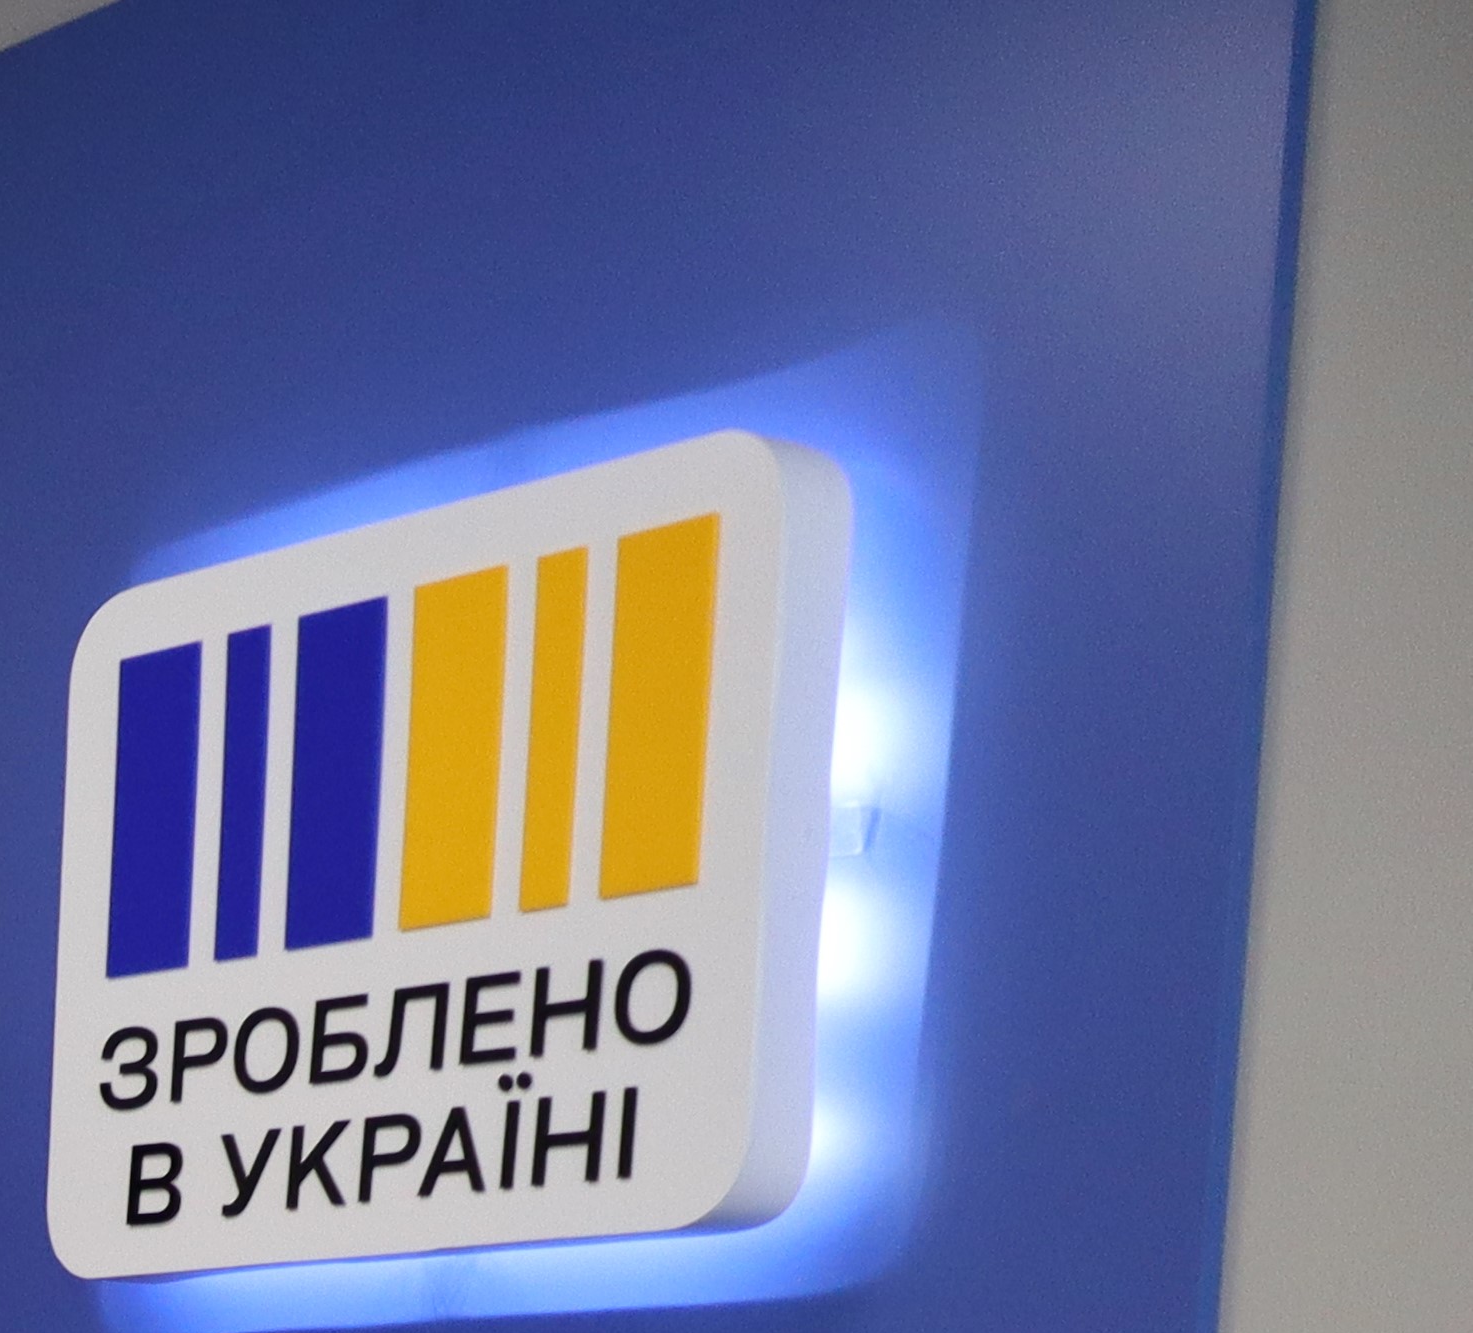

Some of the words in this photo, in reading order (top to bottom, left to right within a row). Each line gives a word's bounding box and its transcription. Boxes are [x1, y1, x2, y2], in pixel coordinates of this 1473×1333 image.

[98, 948, 693, 1112] ЗРОБЛЕНО
[125, 1142, 183, 1228] В
[220, 1071, 639, 1219] УКРАЇНІ
